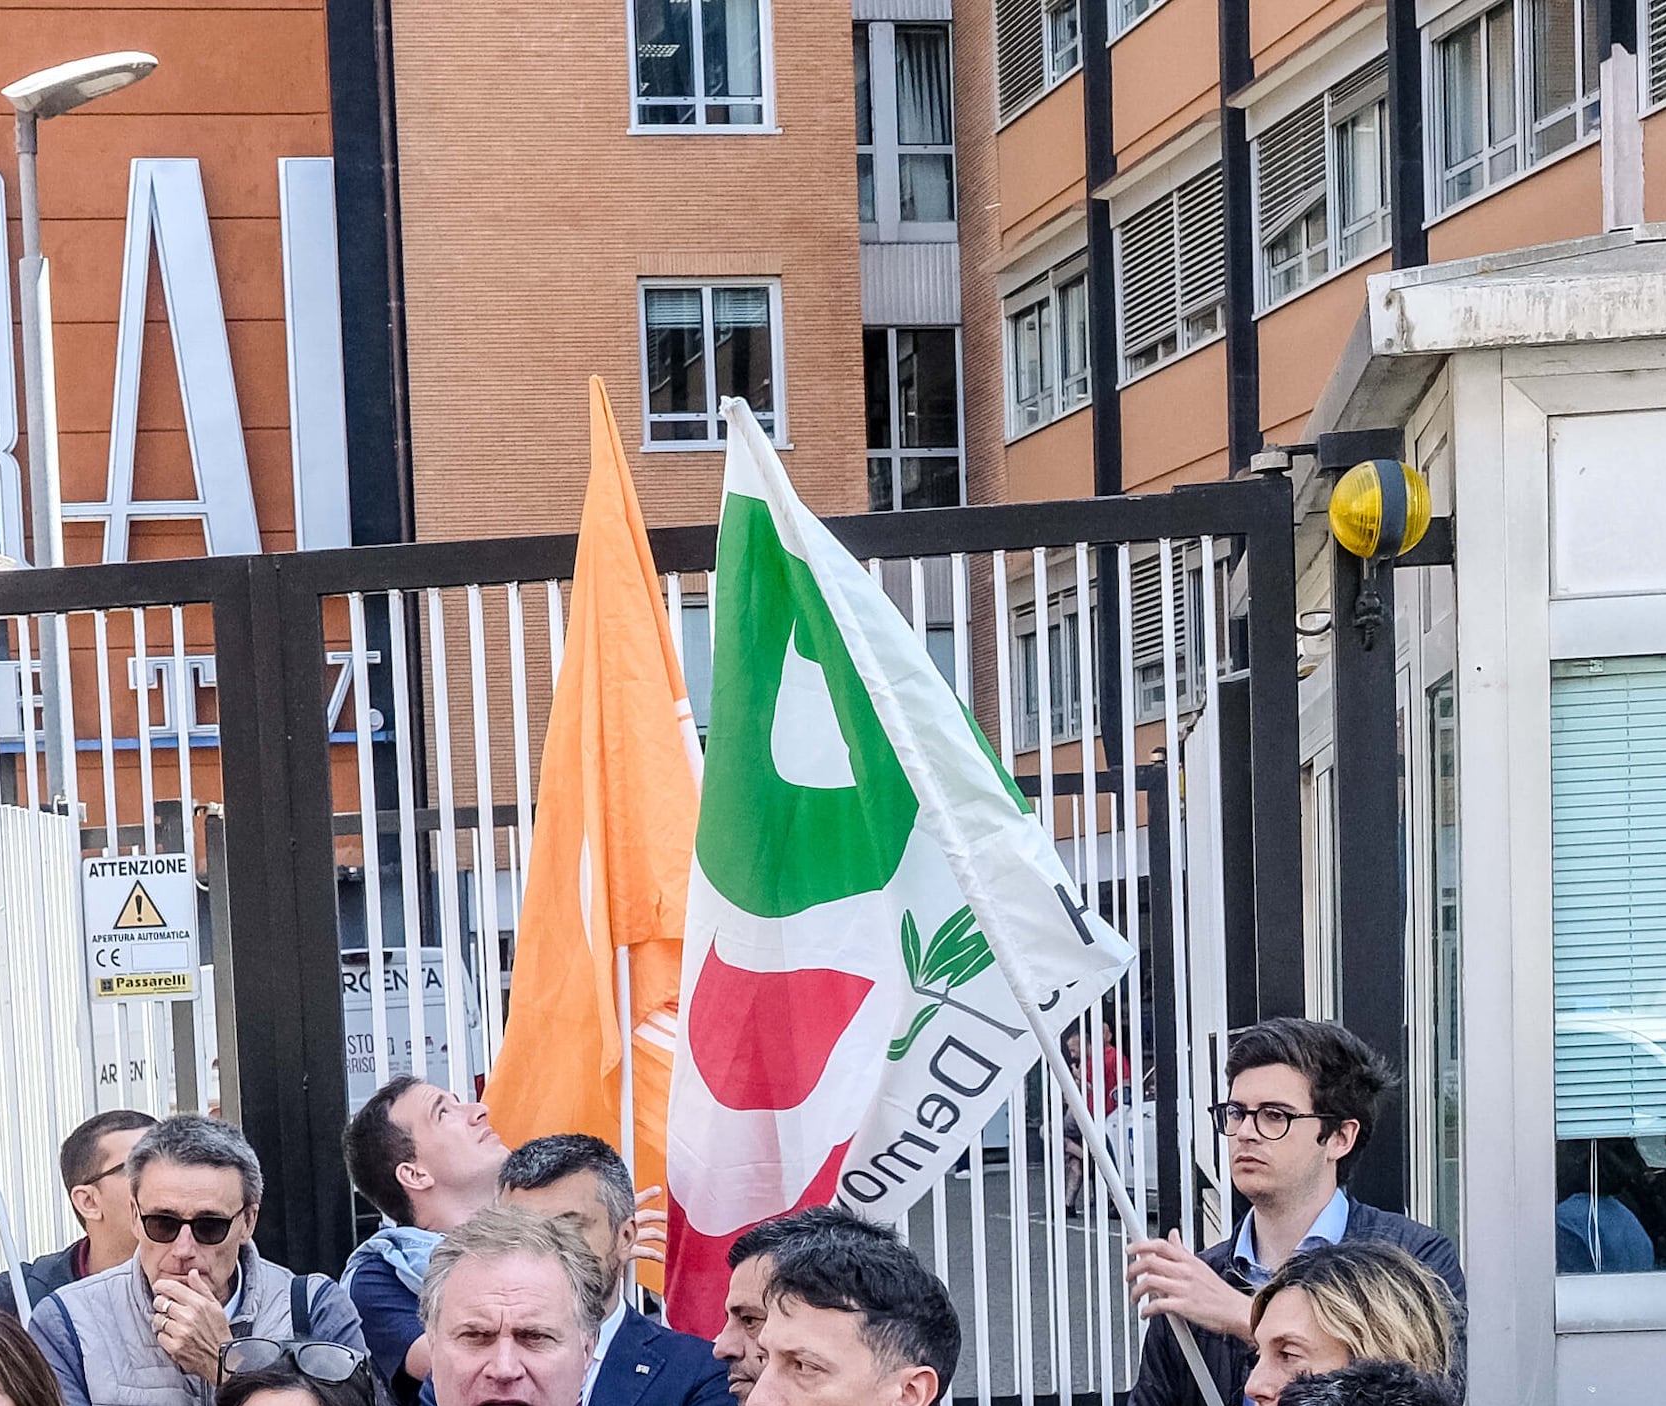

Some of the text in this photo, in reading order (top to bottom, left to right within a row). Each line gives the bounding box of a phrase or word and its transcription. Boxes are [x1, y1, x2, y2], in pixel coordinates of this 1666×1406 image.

[88, 858, 187, 878] ATTENZIONE
[92, 930, 190, 943] APERTURA AUTOMATICA
[116, 974, 186, 988] Passarelli
